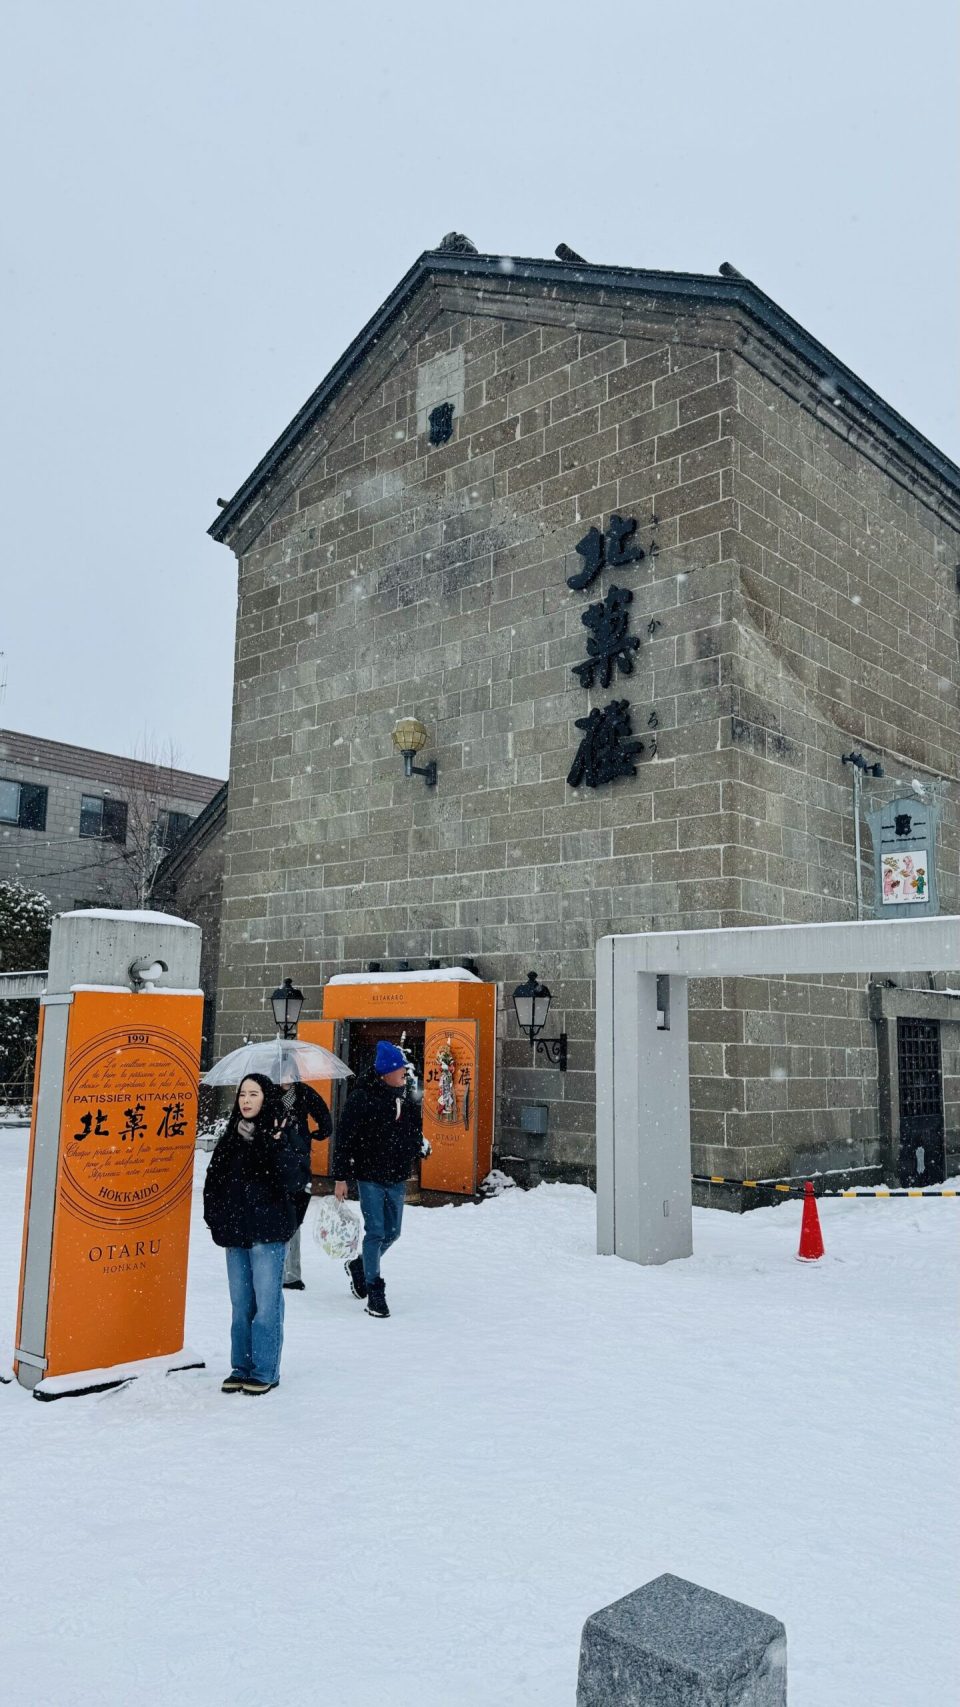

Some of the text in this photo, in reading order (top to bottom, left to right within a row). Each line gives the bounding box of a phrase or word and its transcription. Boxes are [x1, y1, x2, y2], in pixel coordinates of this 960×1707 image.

[126, 1034, 150, 1045] 1991
[426, 1067, 472, 1085] 北楼
[73, 1091, 193, 1104] PATISSIER KITAKARO
[74, 1102, 188, 1142] 北菓楼
[99, 1183, 160, 1203] HOKKAIDO
[88, 1239, 162, 1262] OTARU
[102, 1262, 147, 1274] HONKAN
